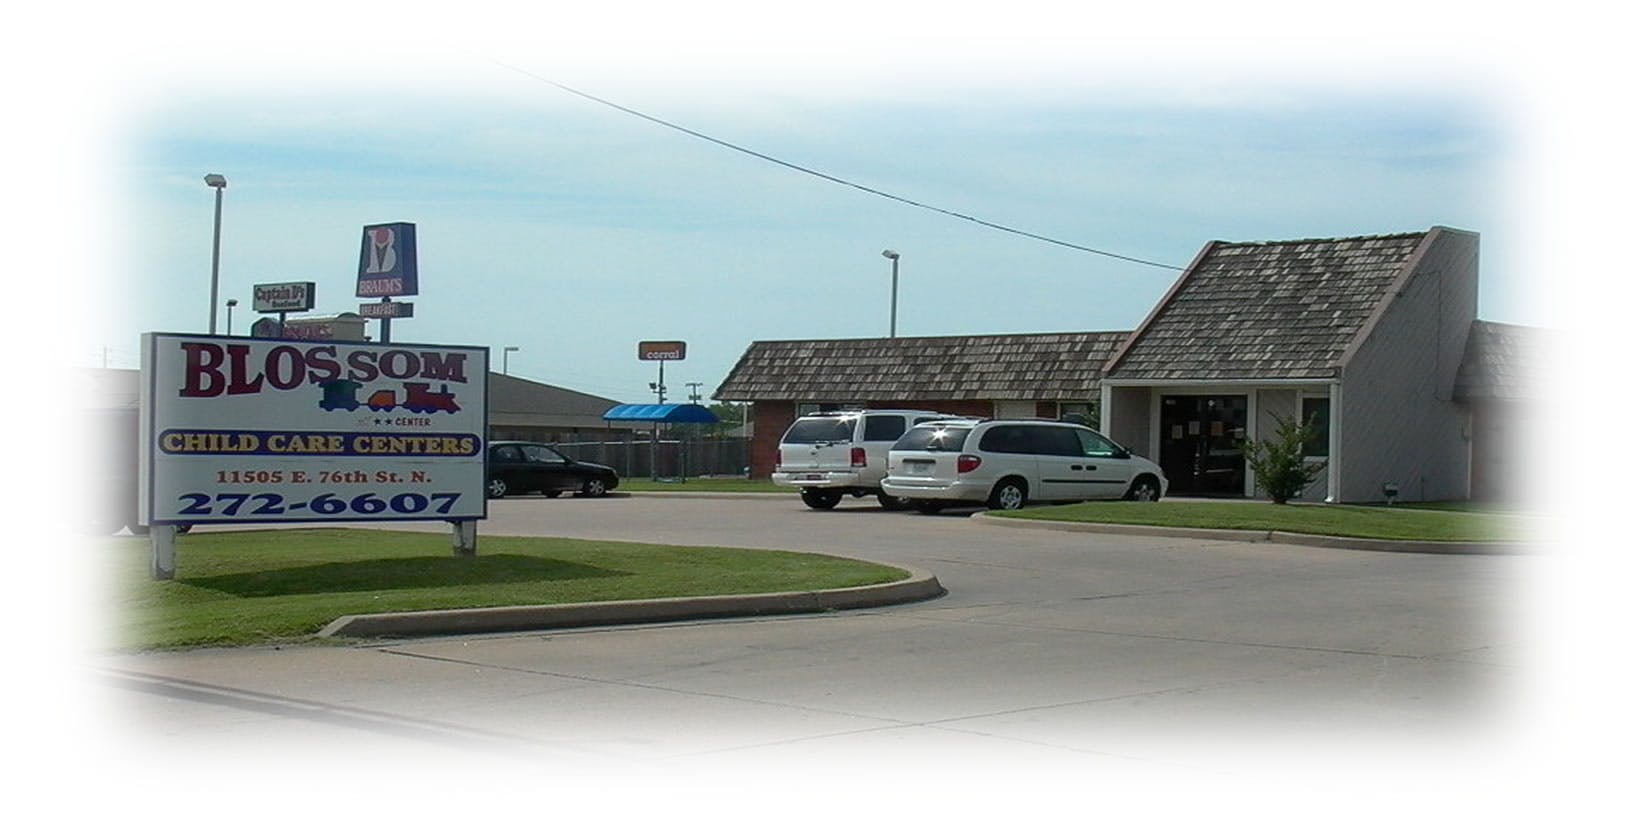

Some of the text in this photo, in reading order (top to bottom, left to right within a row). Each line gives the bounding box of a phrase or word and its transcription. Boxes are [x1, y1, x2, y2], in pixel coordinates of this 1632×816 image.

[255, 287, 290, 303] Captain
[647, 350, 680, 359] corral
[179, 342, 468, 398] BLOSSOM
[395, 417, 431, 427] CENTER
[163, 433, 475, 455] CHILD CARE CENTERS
[216, 470, 432, 484] 11505 E. 76th St. N.
[177, 492, 462, 516] 272-6607
